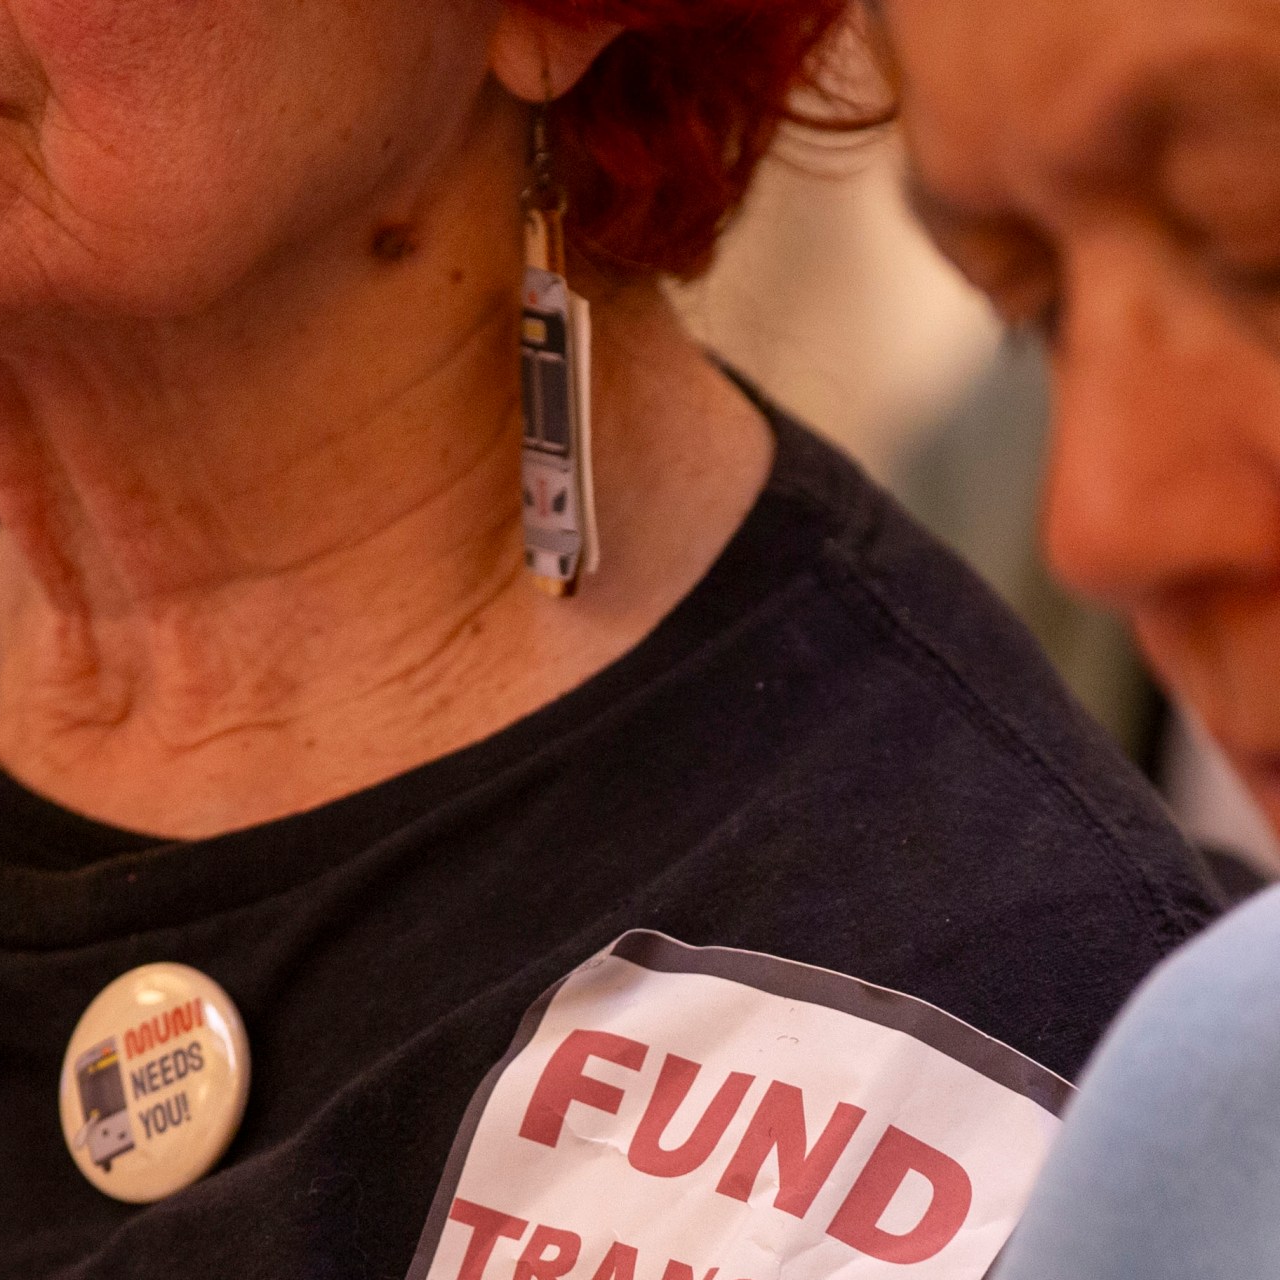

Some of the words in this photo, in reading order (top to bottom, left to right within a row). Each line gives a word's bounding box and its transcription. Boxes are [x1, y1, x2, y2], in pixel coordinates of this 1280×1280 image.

[123, 997, 204, 1060] MUNI
[130, 1040, 205, 1101] NEEDS
[137, 1091, 192, 1140] YOU!
[516, 1028, 973, 1265] FUND
